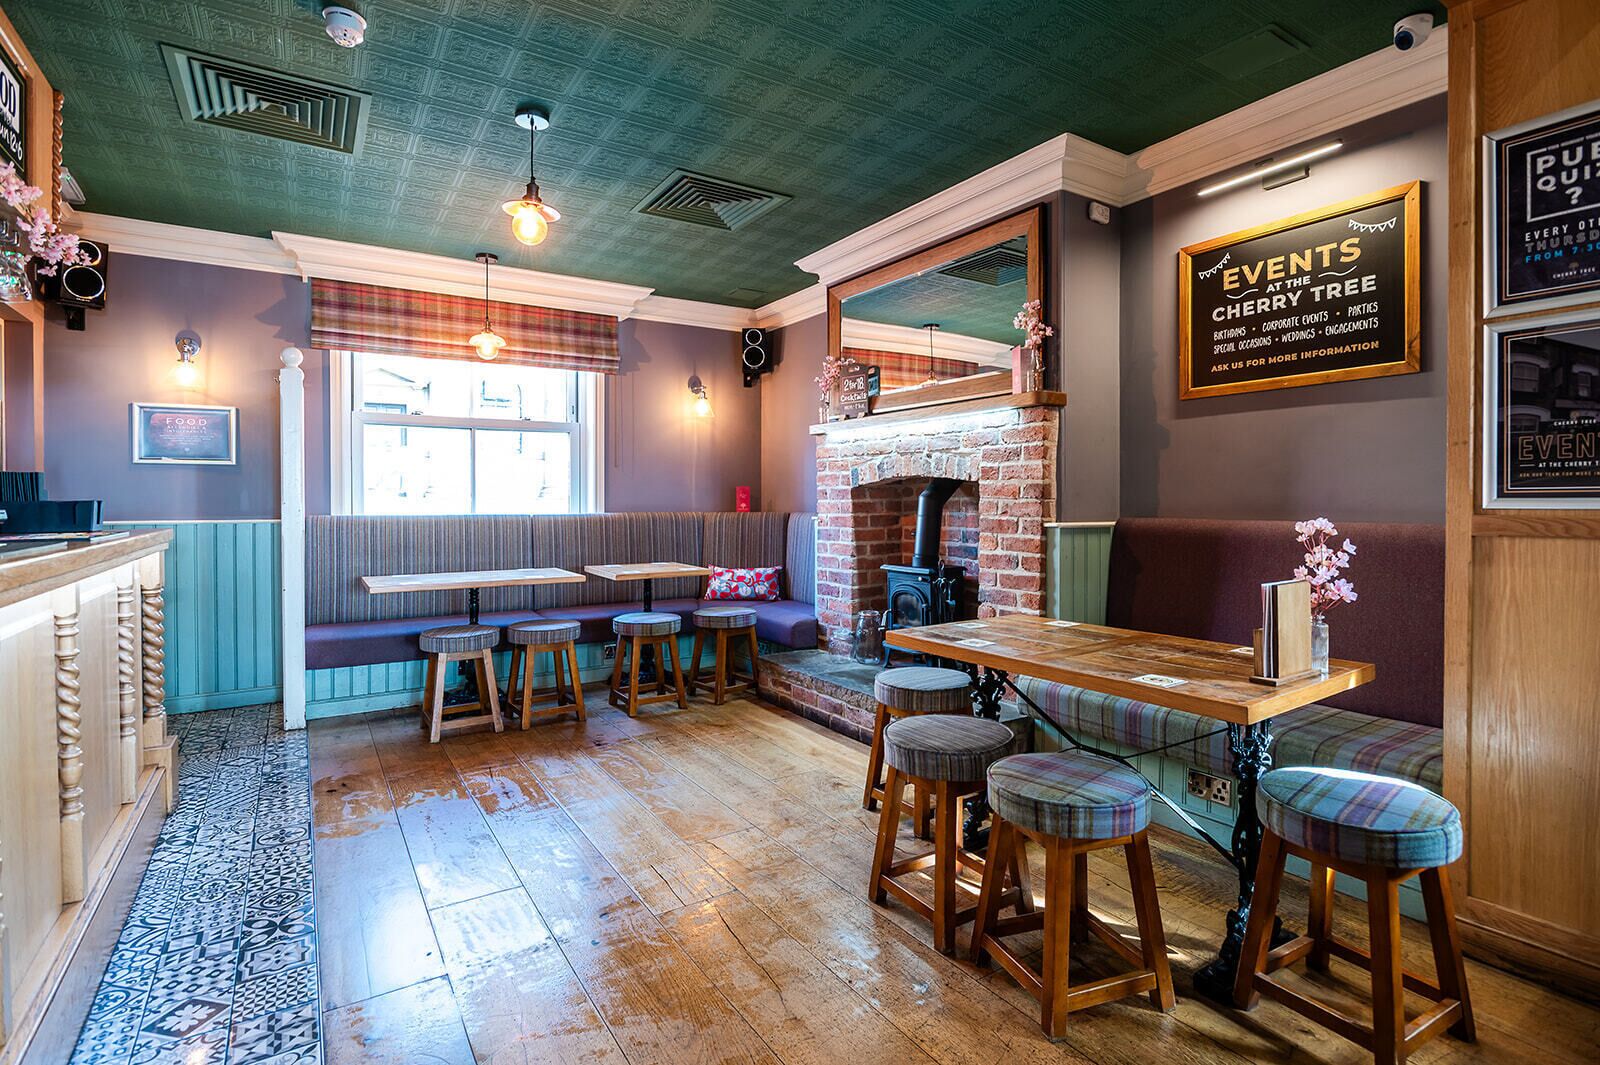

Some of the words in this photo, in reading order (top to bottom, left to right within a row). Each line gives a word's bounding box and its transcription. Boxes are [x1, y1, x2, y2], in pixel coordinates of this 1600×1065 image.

[1525, 223, 1569, 242] EVERY
[1223, 237, 1362, 291] EVENTS
[1525, 249, 1563, 264] FROM
[1265, 281, 1282, 294] AT
[1285, 275, 1311, 289] THE
[1212, 289, 1302, 322] CHERRY
[1310, 274, 1377, 302] TREE
[1213, 326, 1246, 341] BIRTHDAYS
[1262, 316, 1299, 332] CORPORATE
[1302, 310, 1329, 325] EVENTS
[1347, 301, 1379, 317] PARTIES
[1213, 342, 1236, 355] SPECIAL
[1238, 335, 1272, 350] OCCASIONS
[1281, 328, 1316, 343] WEDDINGS
[1325, 317, 1379, 336] ENGAGEMENTS
[1210, 363, 1230, 373] ASK
[1231, 361, 1244, 369] US
[1246, 358, 1266, 368] FOR
[1268, 352, 1298, 364] MORE
[1300, 340, 1380, 360] INFORMATION
[844, 379, 849, 391] 2
[166, 417, 207, 426] FOOD
[1519, 432, 1600, 460] EVEN
[1549, 460, 1562, 468] THE
[1564, 460, 1592, 468] CHERRY
